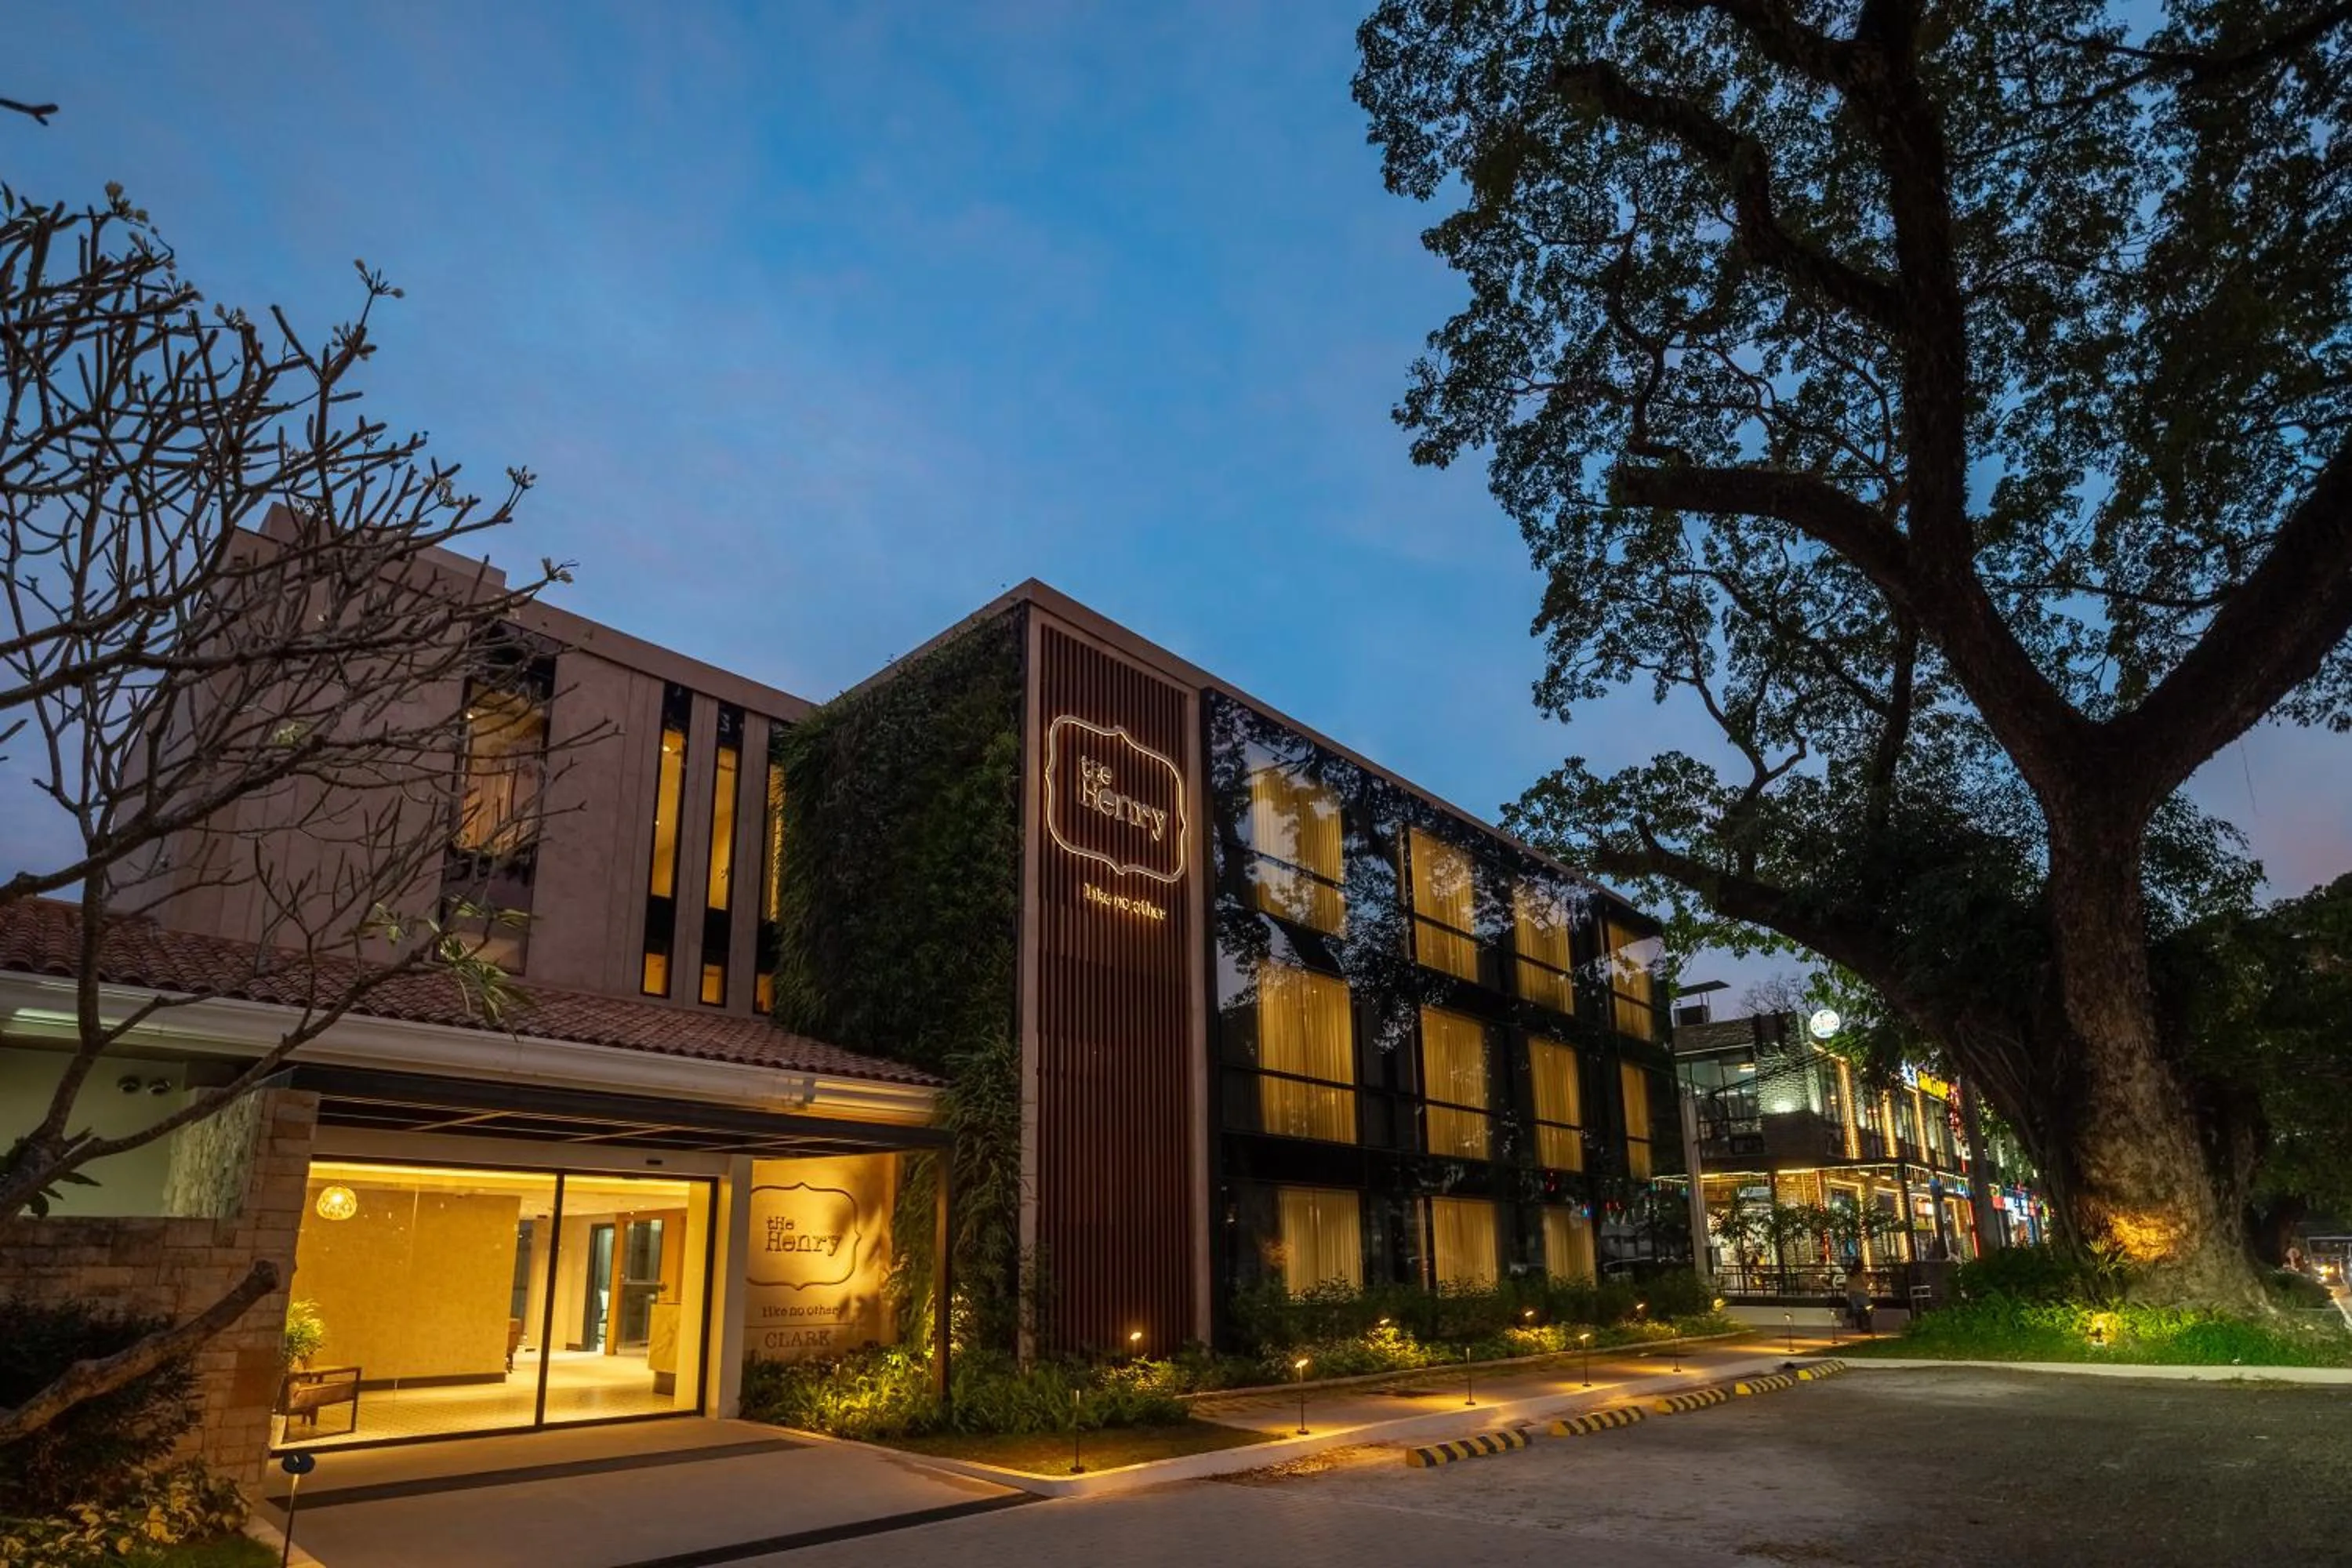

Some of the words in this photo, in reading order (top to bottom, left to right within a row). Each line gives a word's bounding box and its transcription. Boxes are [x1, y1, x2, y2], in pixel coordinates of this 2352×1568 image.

[1080, 779, 1167, 841] Henry
[1114, 895, 1129, 910] no
[1133, 899, 1167, 920] other
[765, 1230, 841, 1257] Henry
[789, 1305, 804, 1316] no
[764, 1330, 830, 1348] CLARK
